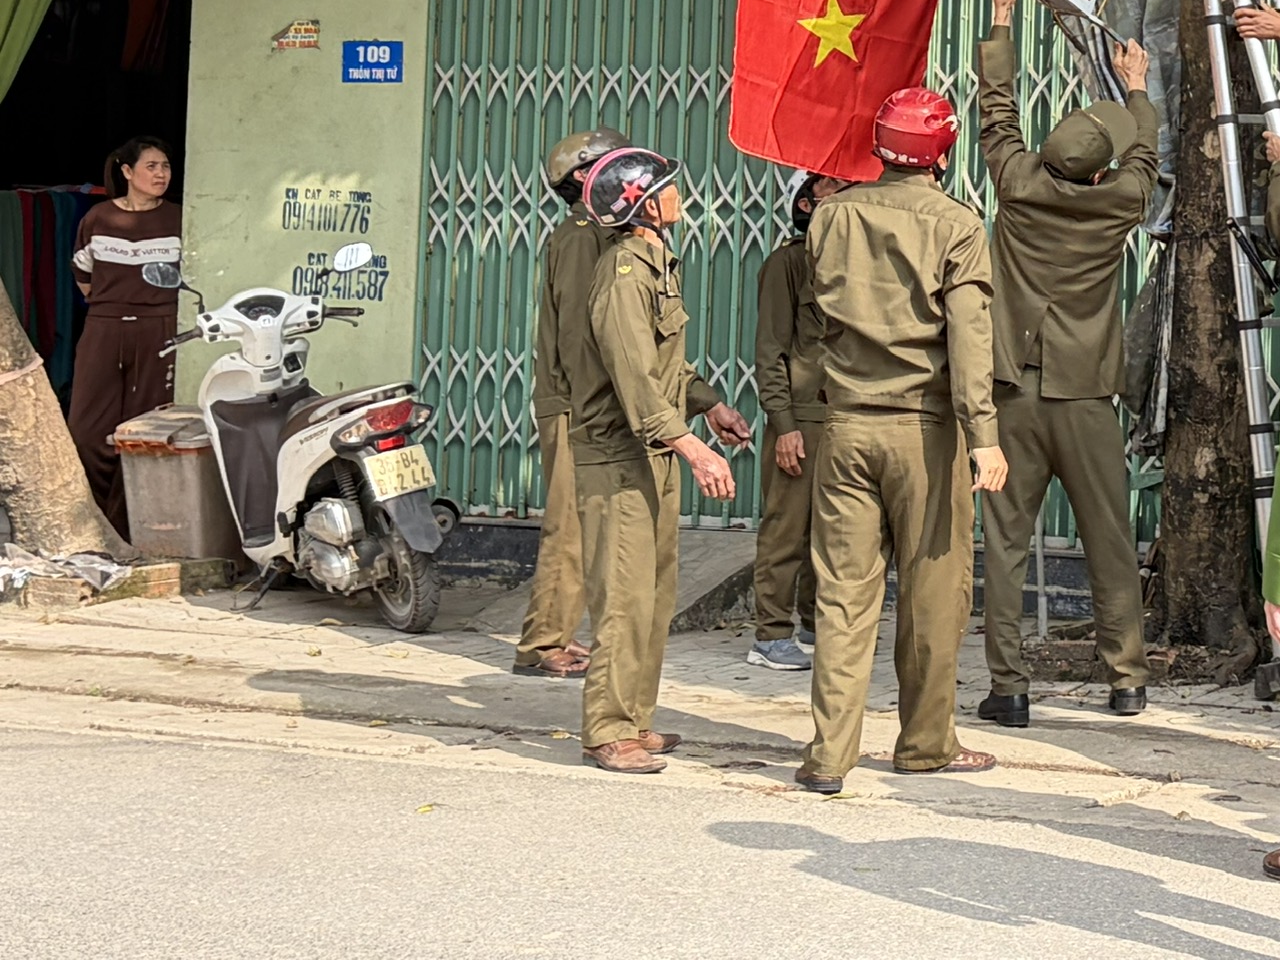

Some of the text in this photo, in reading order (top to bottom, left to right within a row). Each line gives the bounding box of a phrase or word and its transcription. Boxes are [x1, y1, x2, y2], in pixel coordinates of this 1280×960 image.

[356, 45, 391, 63] 109
[371, 67, 385, 82] THỊ
[304, 188, 322, 200] CAT
[349, 191, 372, 203] TONG
[307, 252, 328, 266] CAT
